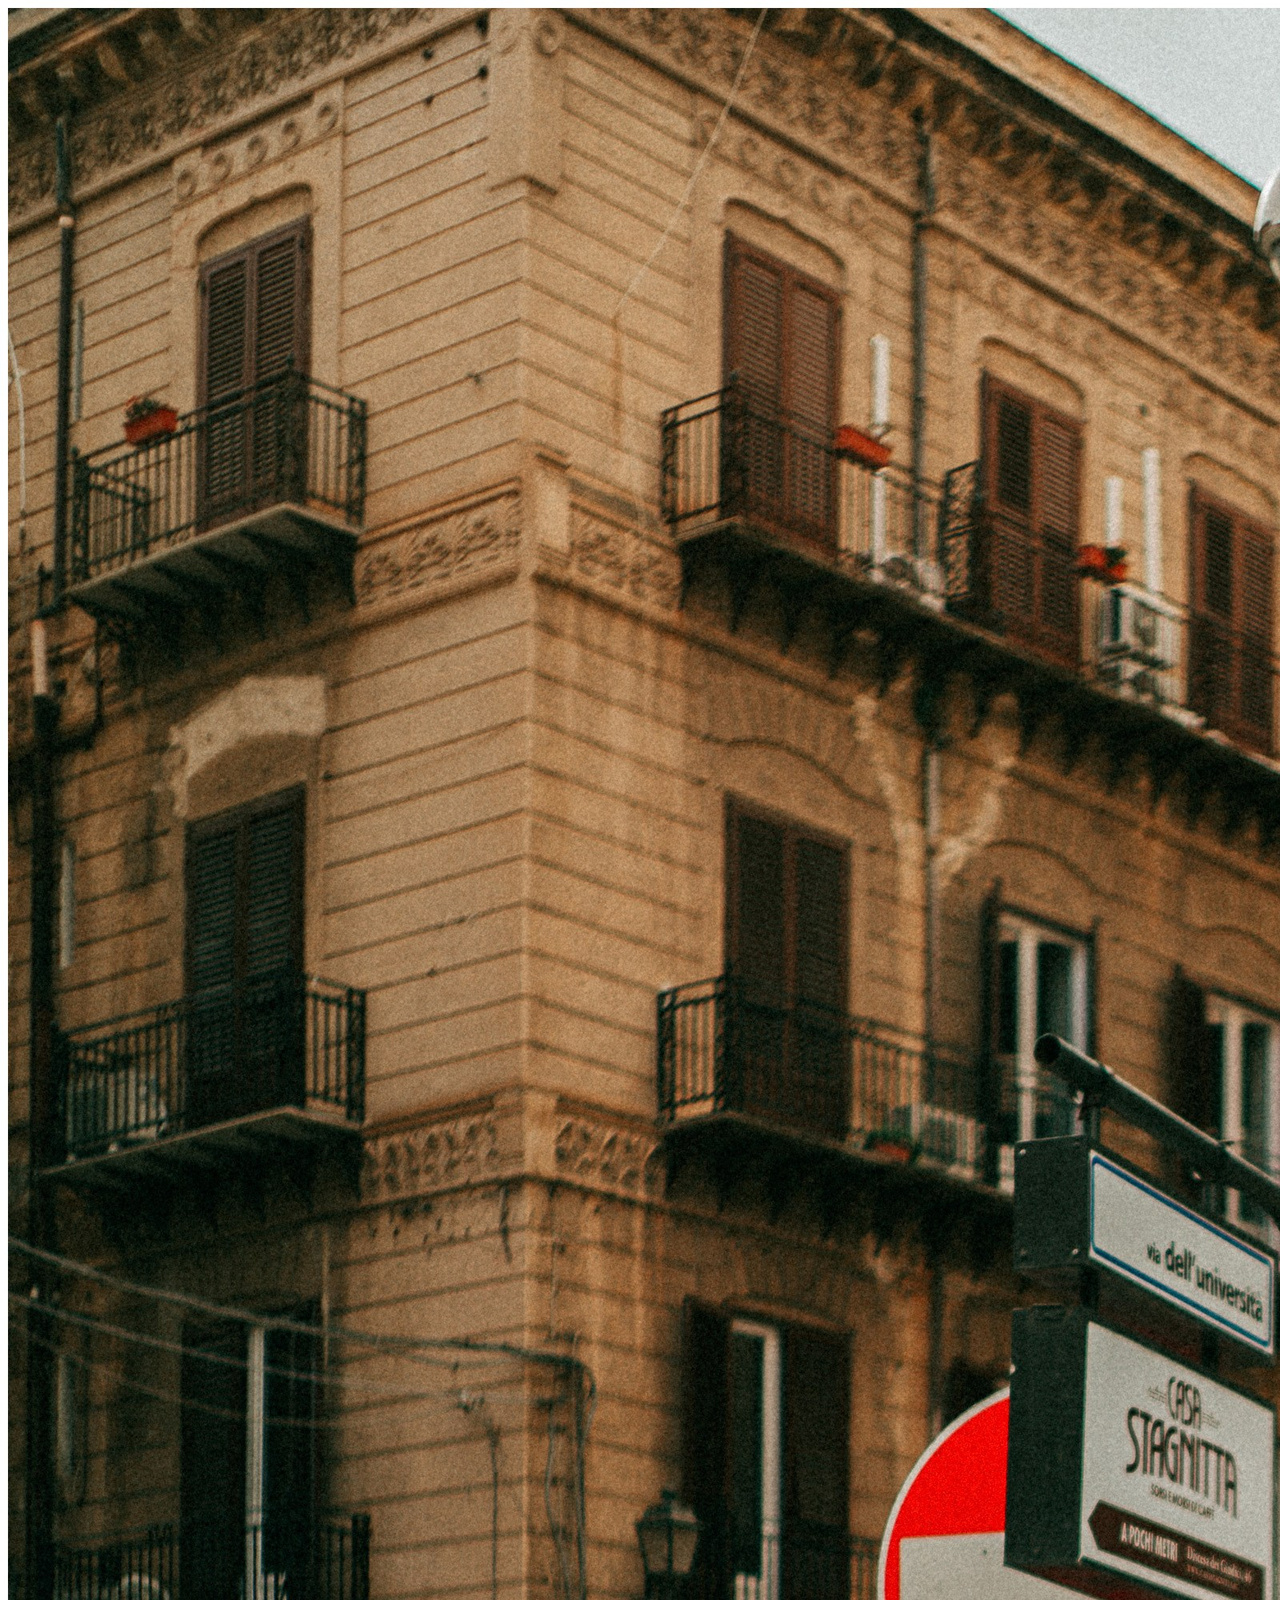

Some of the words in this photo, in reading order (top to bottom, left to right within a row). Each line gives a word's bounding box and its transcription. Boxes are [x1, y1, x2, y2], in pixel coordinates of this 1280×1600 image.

[1146, 1241, 1162, 1265] via
[1167, 1375, 1202, 1430] CASA
[1125, 1406, 1238, 1520] STAGNITTA
[1121, 1522, 1128, 1543] A
[1129, 1524, 1154, 1552] POCHI
[1155, 1535, 1179, 1563] METRI
